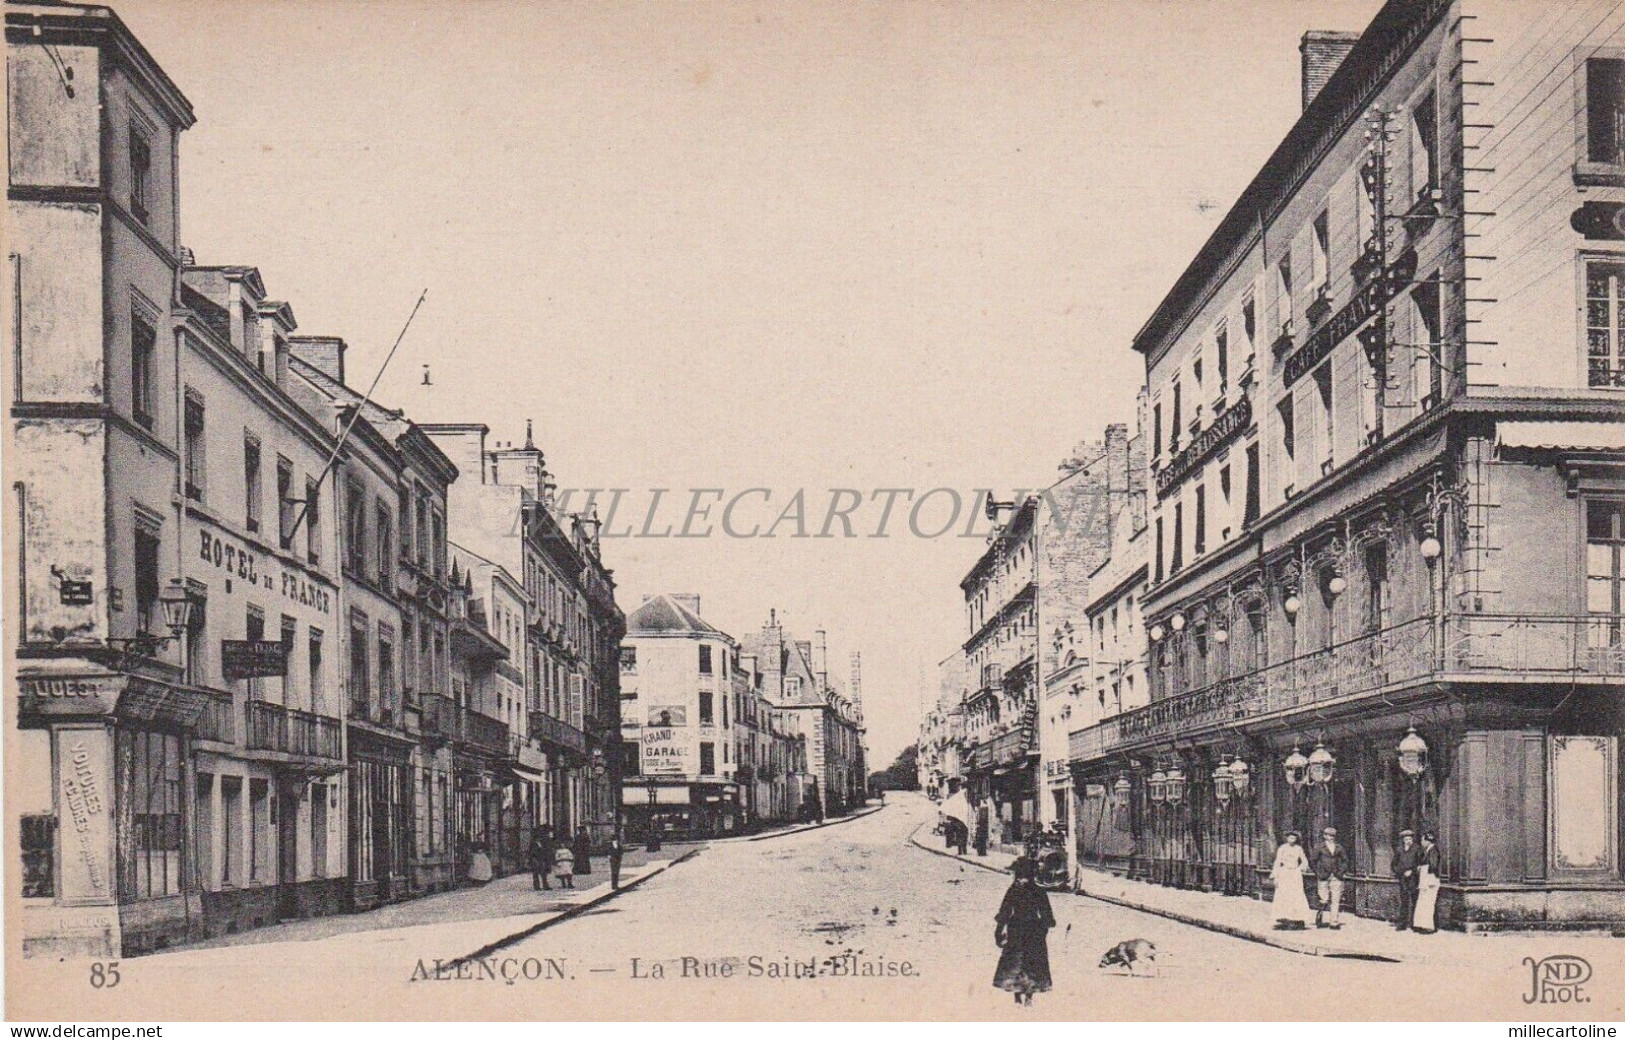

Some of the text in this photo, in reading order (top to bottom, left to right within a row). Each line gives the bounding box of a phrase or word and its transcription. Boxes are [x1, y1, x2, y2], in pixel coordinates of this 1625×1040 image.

[200, 528, 257, 585] HOTEL
[282, 571, 329, 614] FRANCE
[643, 729, 671, 745] GRAND
[645, 747, 690, 757] GARAGE
[70, 743, 102, 816] VOITURES
